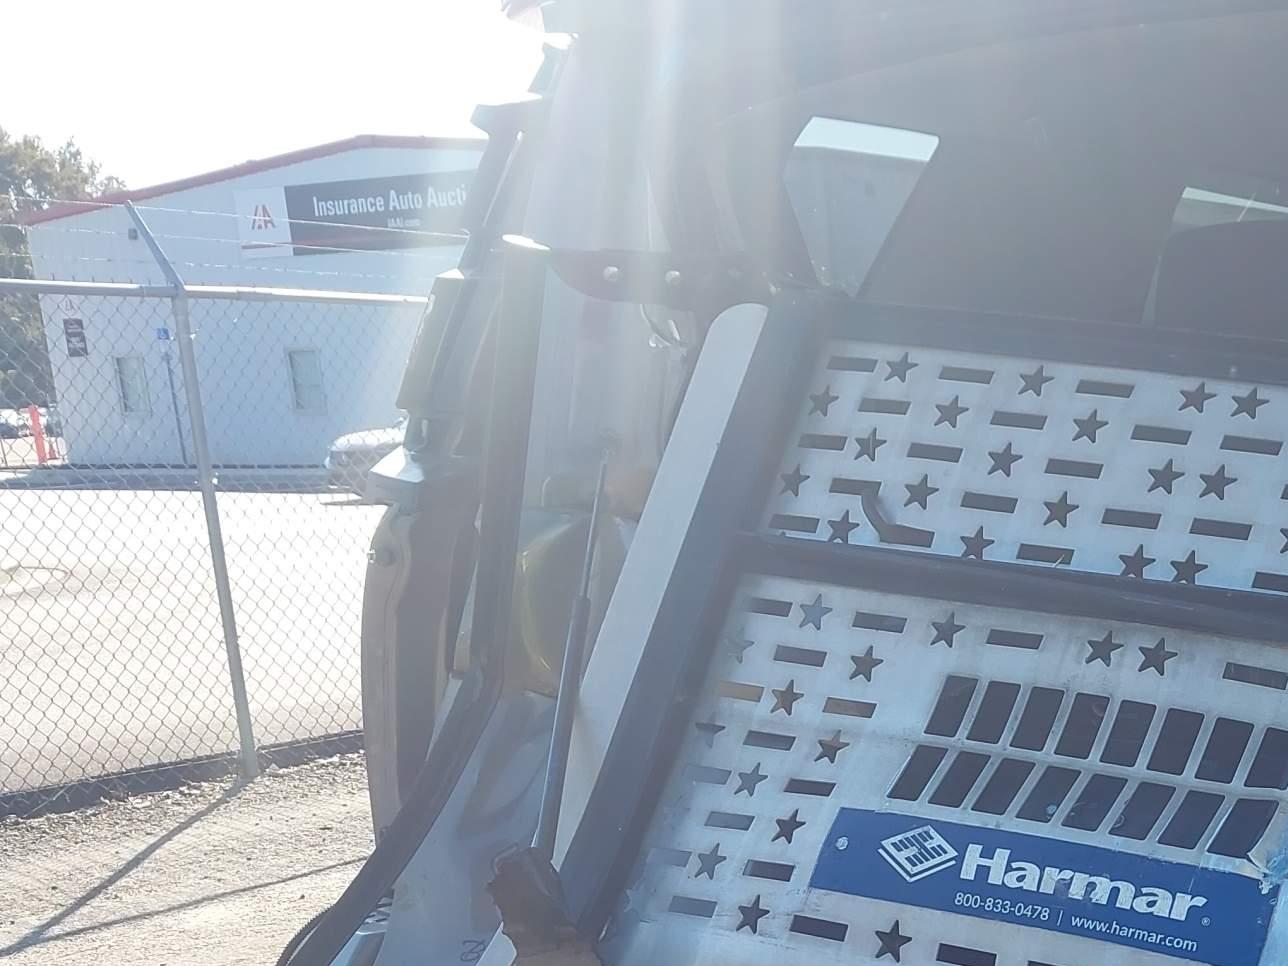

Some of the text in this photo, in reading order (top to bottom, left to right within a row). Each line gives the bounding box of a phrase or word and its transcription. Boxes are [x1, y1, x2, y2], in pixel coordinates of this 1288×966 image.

[312, 196, 384, 217] Insurance
[388, 190, 423, 211] Auto
[954, 892, 1050, 921] 800-833-0478
[1071, 915, 1198, 952] www.harmar.com
